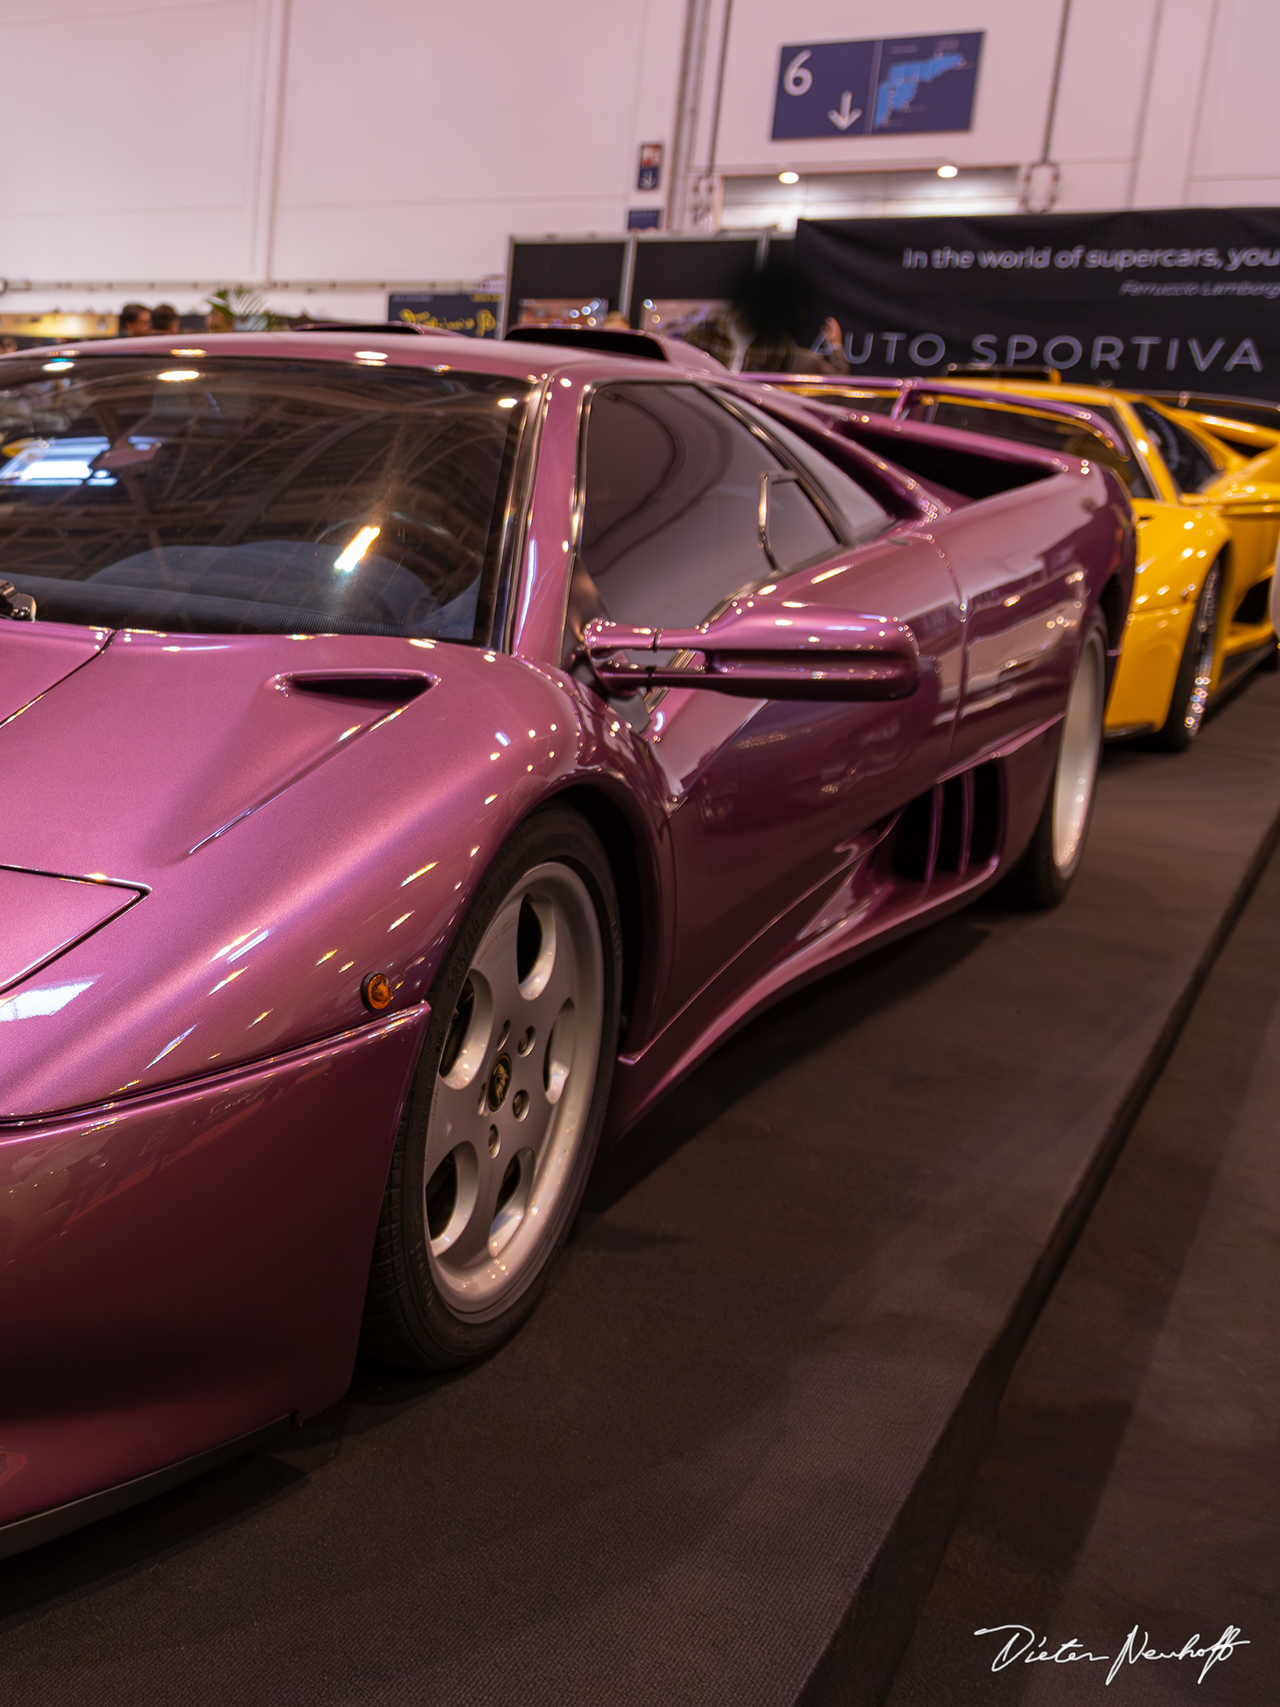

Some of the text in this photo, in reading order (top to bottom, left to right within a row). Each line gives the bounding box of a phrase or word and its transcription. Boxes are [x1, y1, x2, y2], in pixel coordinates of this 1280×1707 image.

[784, 49, 813, 96] 6
[902, 247, 928, 270] In
[931, 246, 975, 270] the
[976, 246, 1052, 270] world
[1053, 244, 1087, 270] of
[1084, 248, 1223, 273] supercars,
[809, 332, 1265, 373] AUTO SPORTIVA
